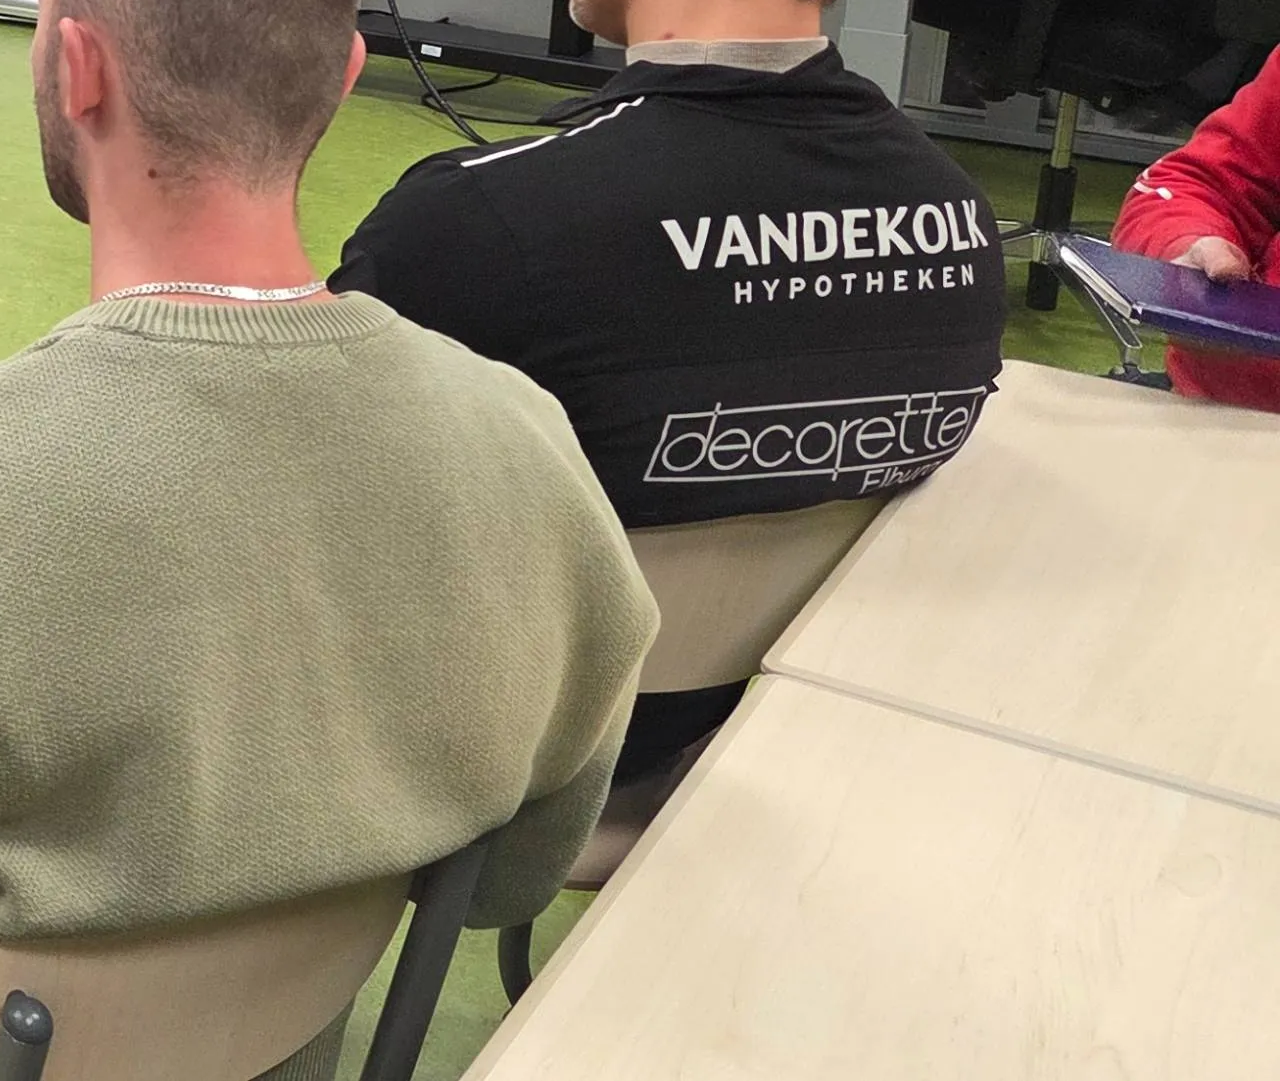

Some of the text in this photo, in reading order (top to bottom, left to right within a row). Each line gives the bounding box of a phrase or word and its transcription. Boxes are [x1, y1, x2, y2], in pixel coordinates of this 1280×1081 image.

[661, 199, 989, 271] VANDEKOLK
[734, 263, 975, 305] HYPOTHEKEN
[660, 394, 970, 482] decorette
